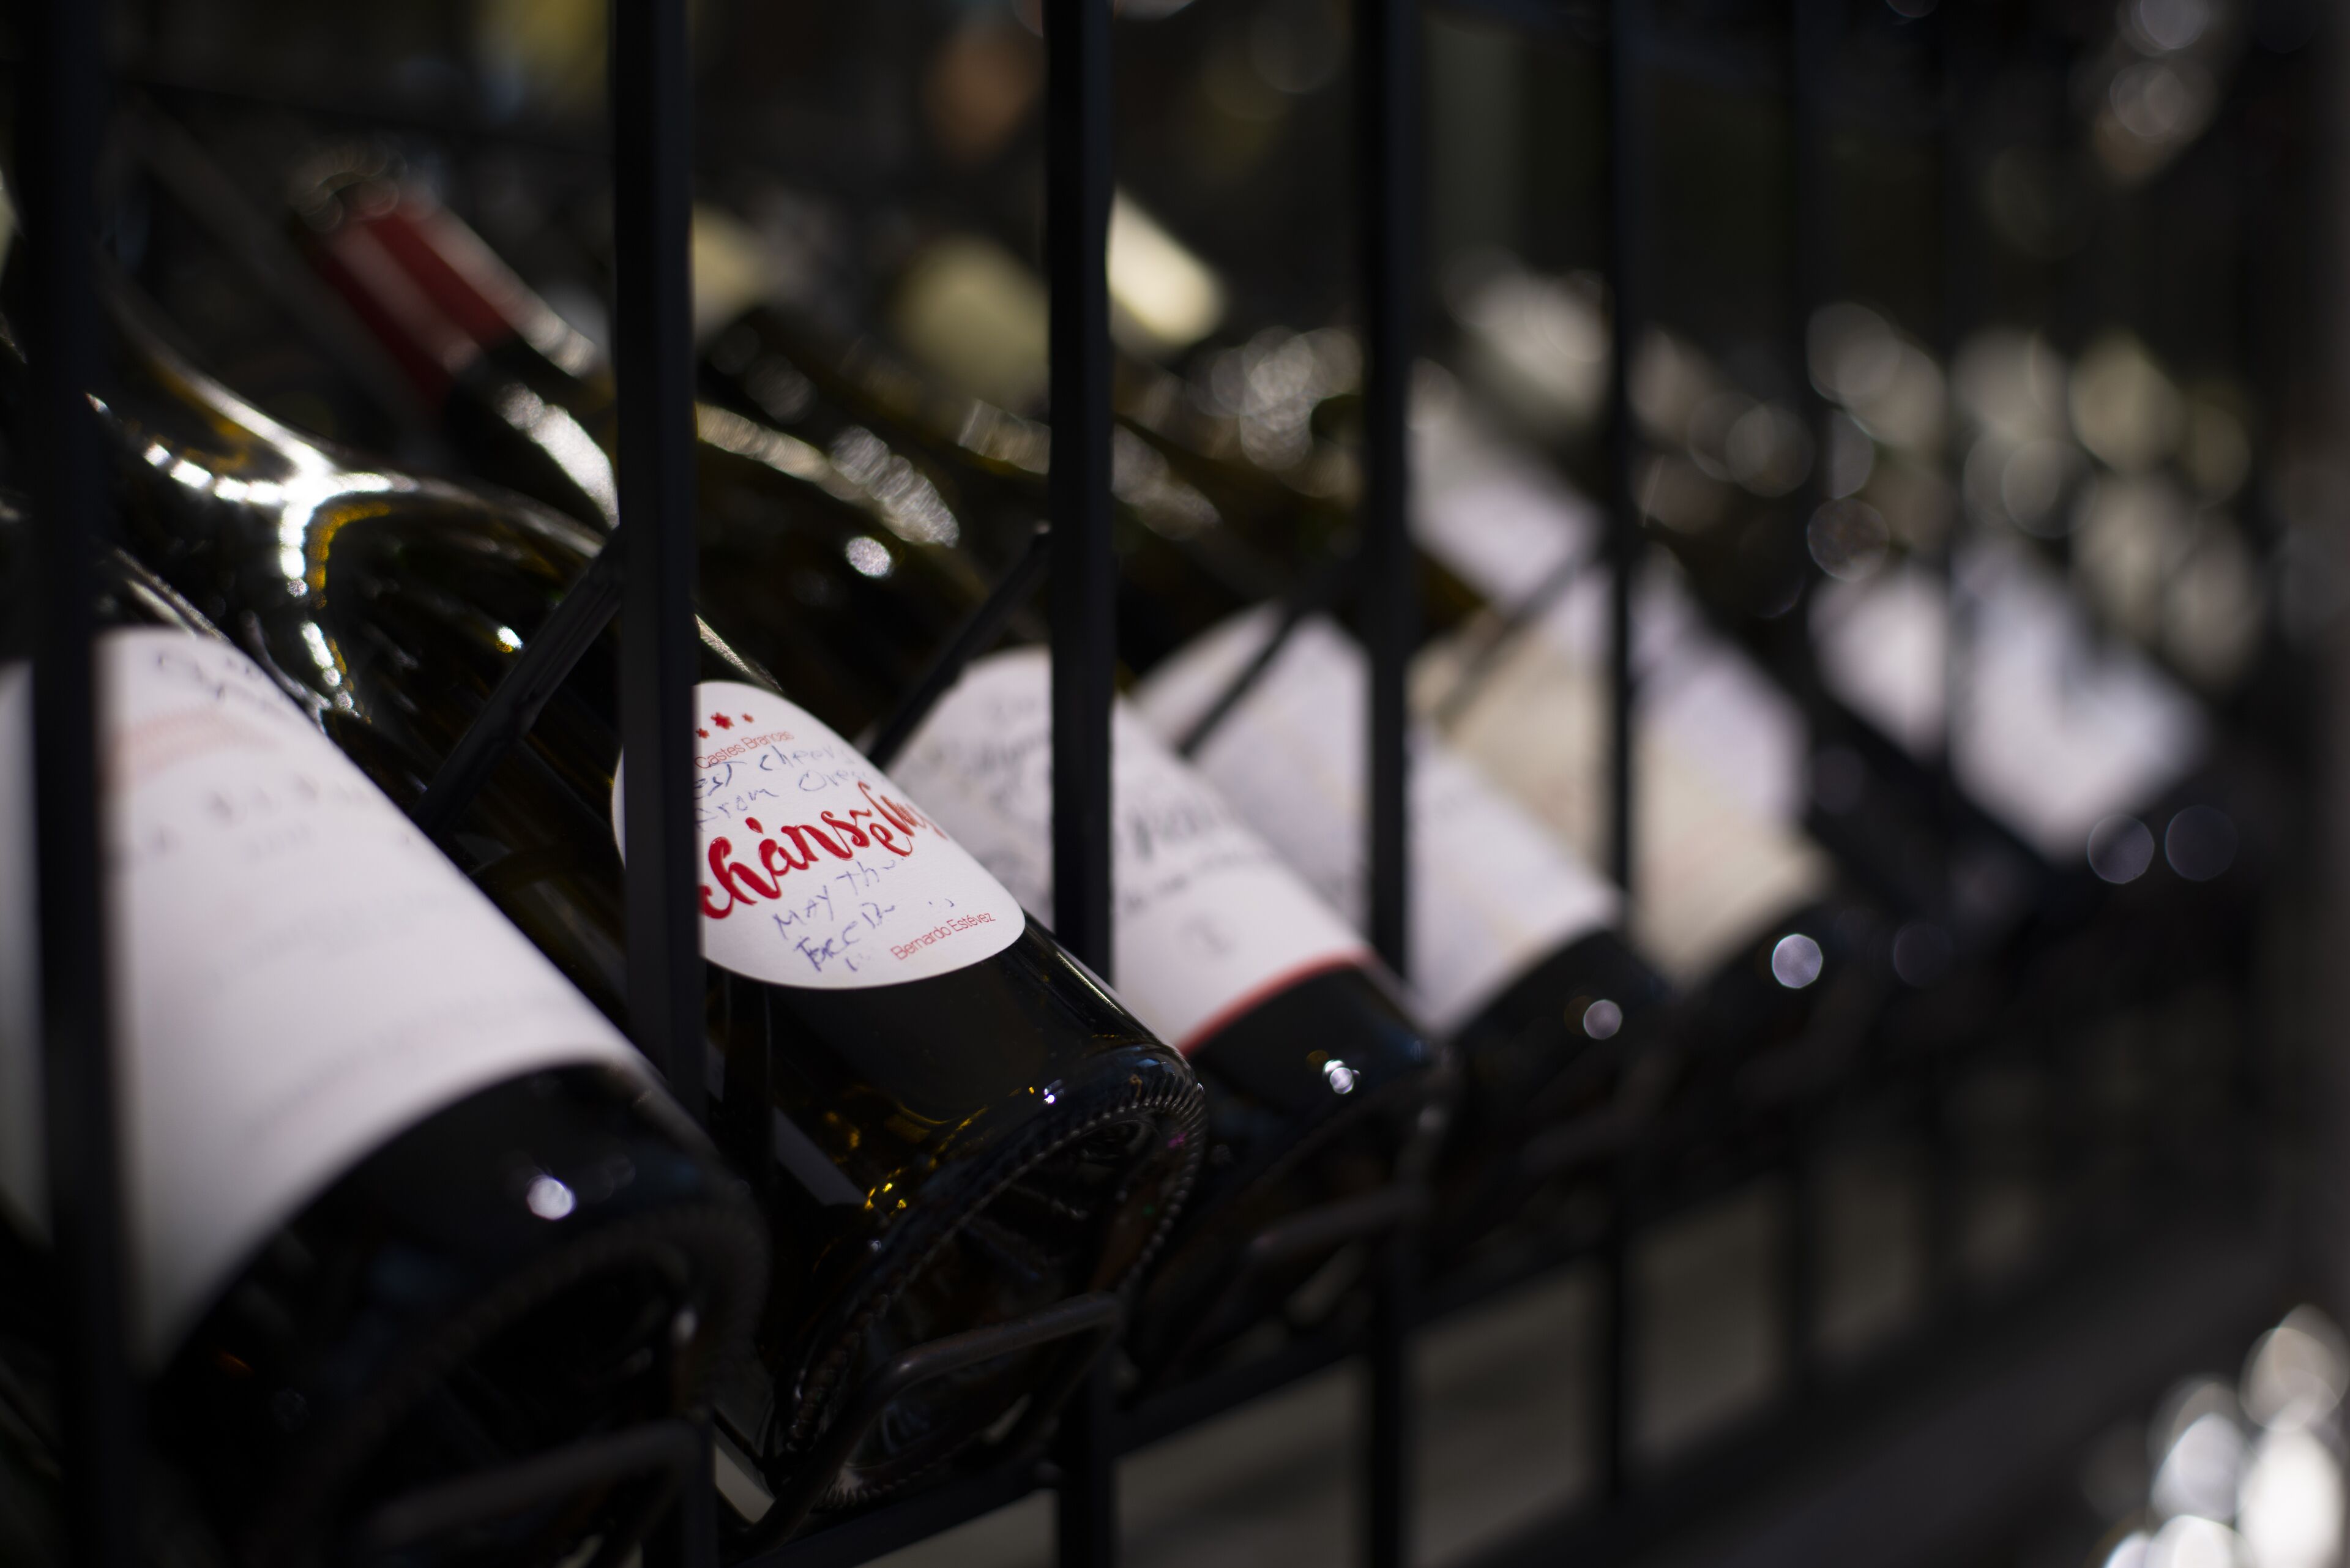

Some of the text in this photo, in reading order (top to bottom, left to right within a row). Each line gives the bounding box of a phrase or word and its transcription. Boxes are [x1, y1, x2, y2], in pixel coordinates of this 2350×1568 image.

[695, 731, 794, 769] Castes Brancas
[890, 913, 996, 960] Bernardo Estévez
